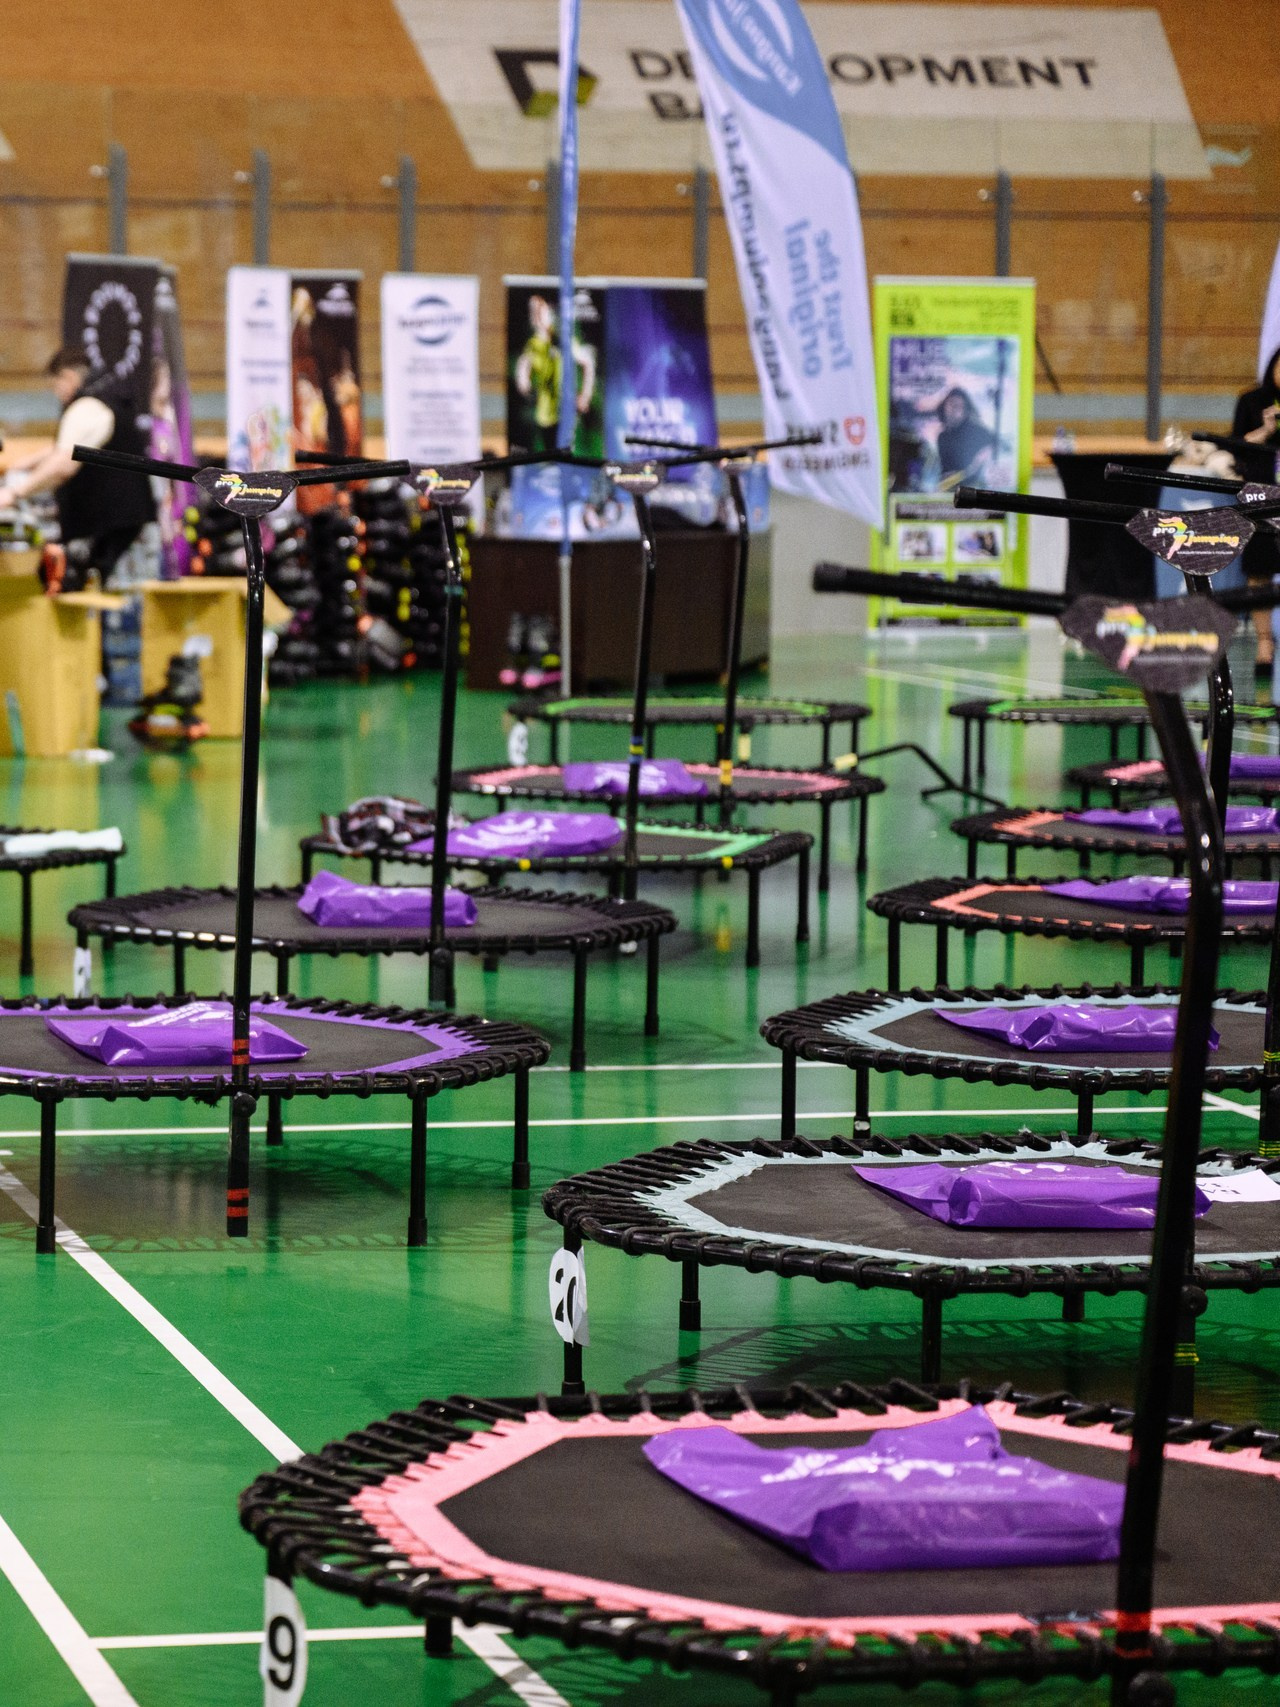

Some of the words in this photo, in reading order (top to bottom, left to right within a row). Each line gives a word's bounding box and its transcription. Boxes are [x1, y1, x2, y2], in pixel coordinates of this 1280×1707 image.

[1245, 491, 1267, 502] pro
[1152, 525, 1176, 537] pro
[267, 1615, 298, 1692] 9
